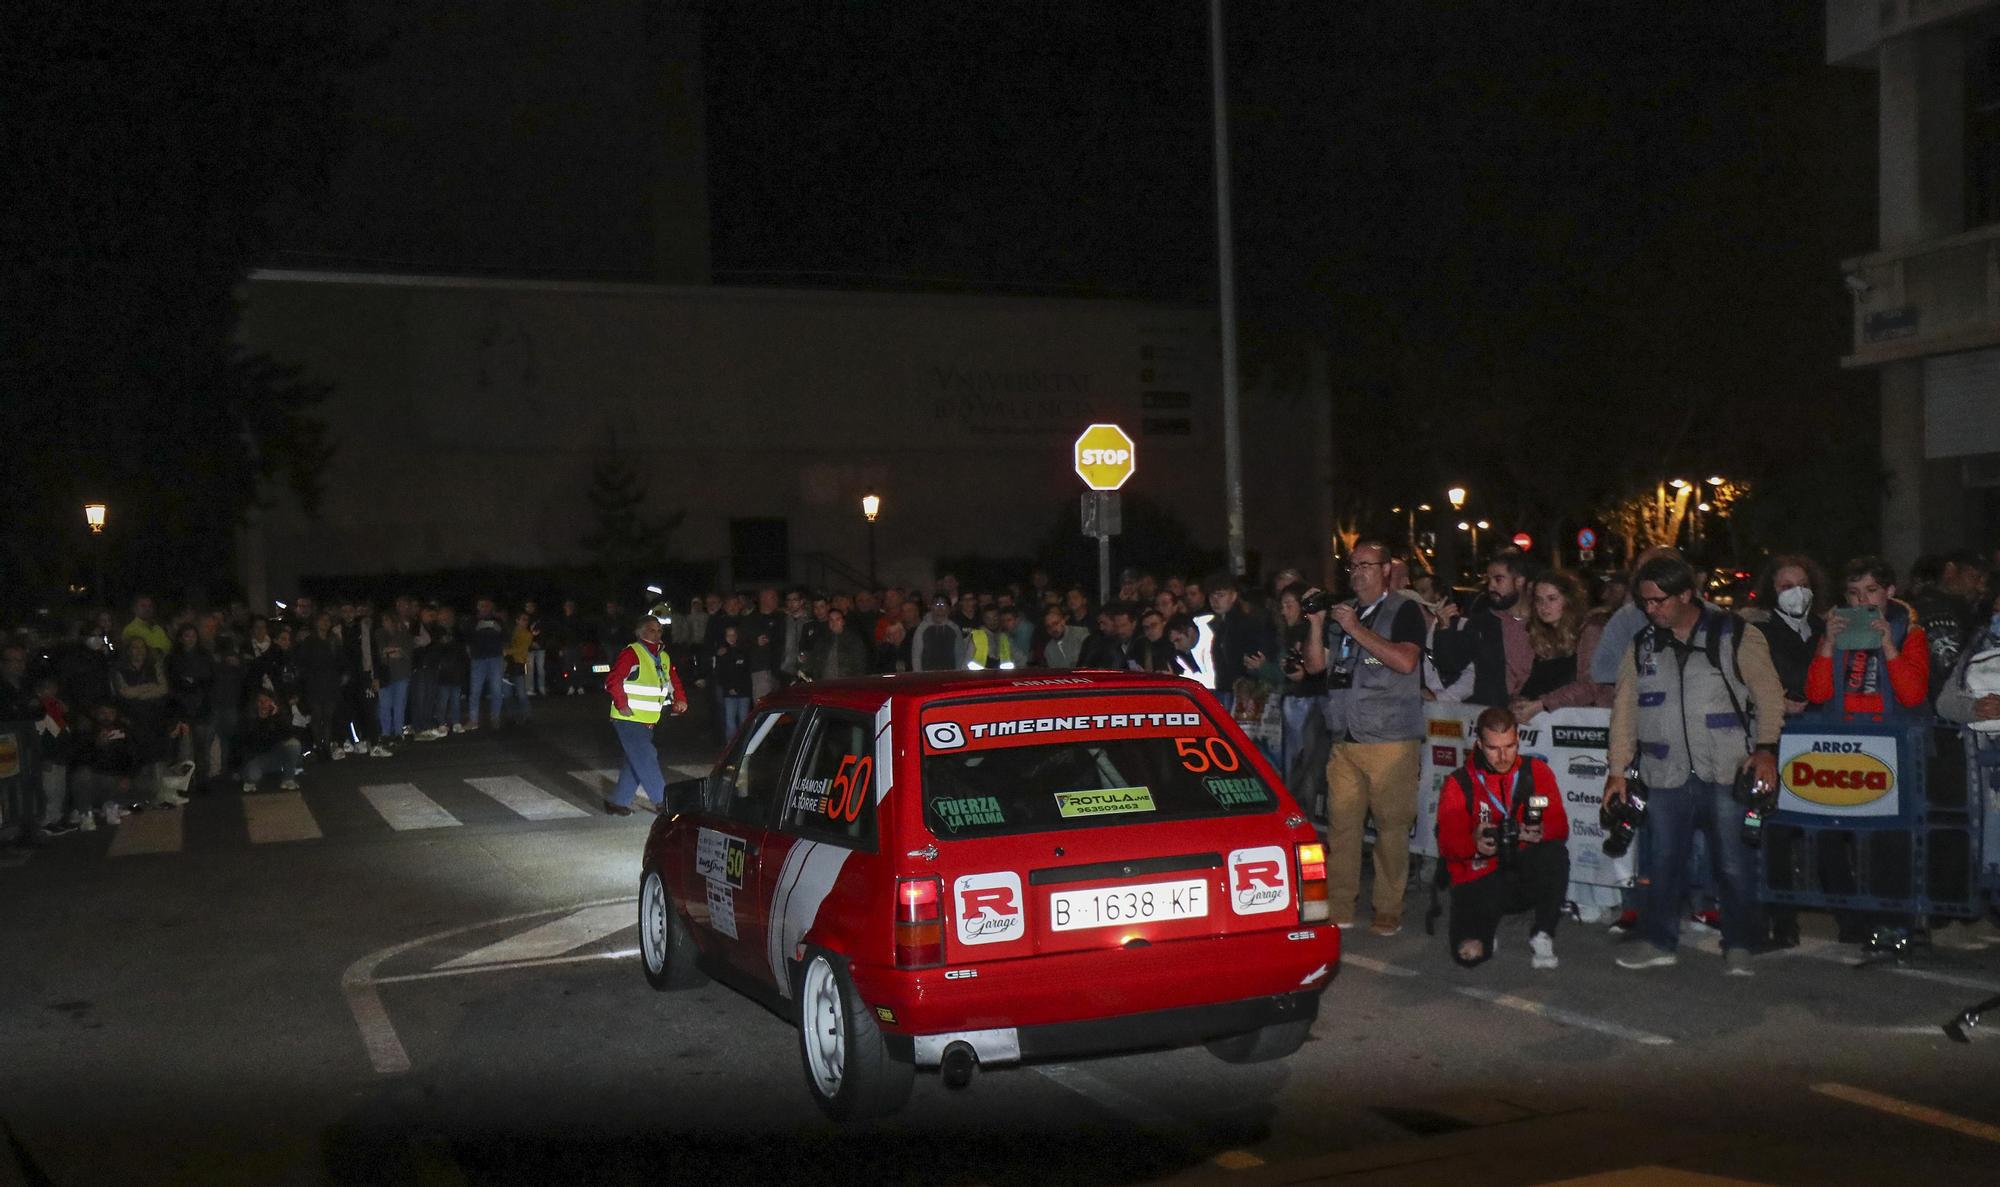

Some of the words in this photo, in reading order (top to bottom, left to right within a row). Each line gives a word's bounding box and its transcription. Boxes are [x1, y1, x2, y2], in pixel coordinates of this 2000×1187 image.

[1081, 449, 1128, 465] STOP
[970, 713, 1200, 738] TIMEONETATTOO
[1175, 737, 1239, 772] 50
[1811, 741, 1863, 753] ARROZ
[828, 755, 873, 822] 50
[1207, 778, 1263, 794] FUERZA
[1791, 762, 1887, 790] Dacsa
[937, 796, 1001, 816] FUERZA
[1219, 793, 1235, 804] LA
[948, 815, 965, 827] LA
[965, 812, 1005, 826] PALMA
[727, 847, 743, 878] 50
[1234, 860, 1284, 891] R
[960, 886, 1018, 919] R
[1056, 899, 1071, 925] B
[1093, 891, 1154, 922] 1638
[1172, 886, 1202, 914] KF
[1239, 884, 1283, 909] Garage
[965, 912, 1016, 939] Garage
